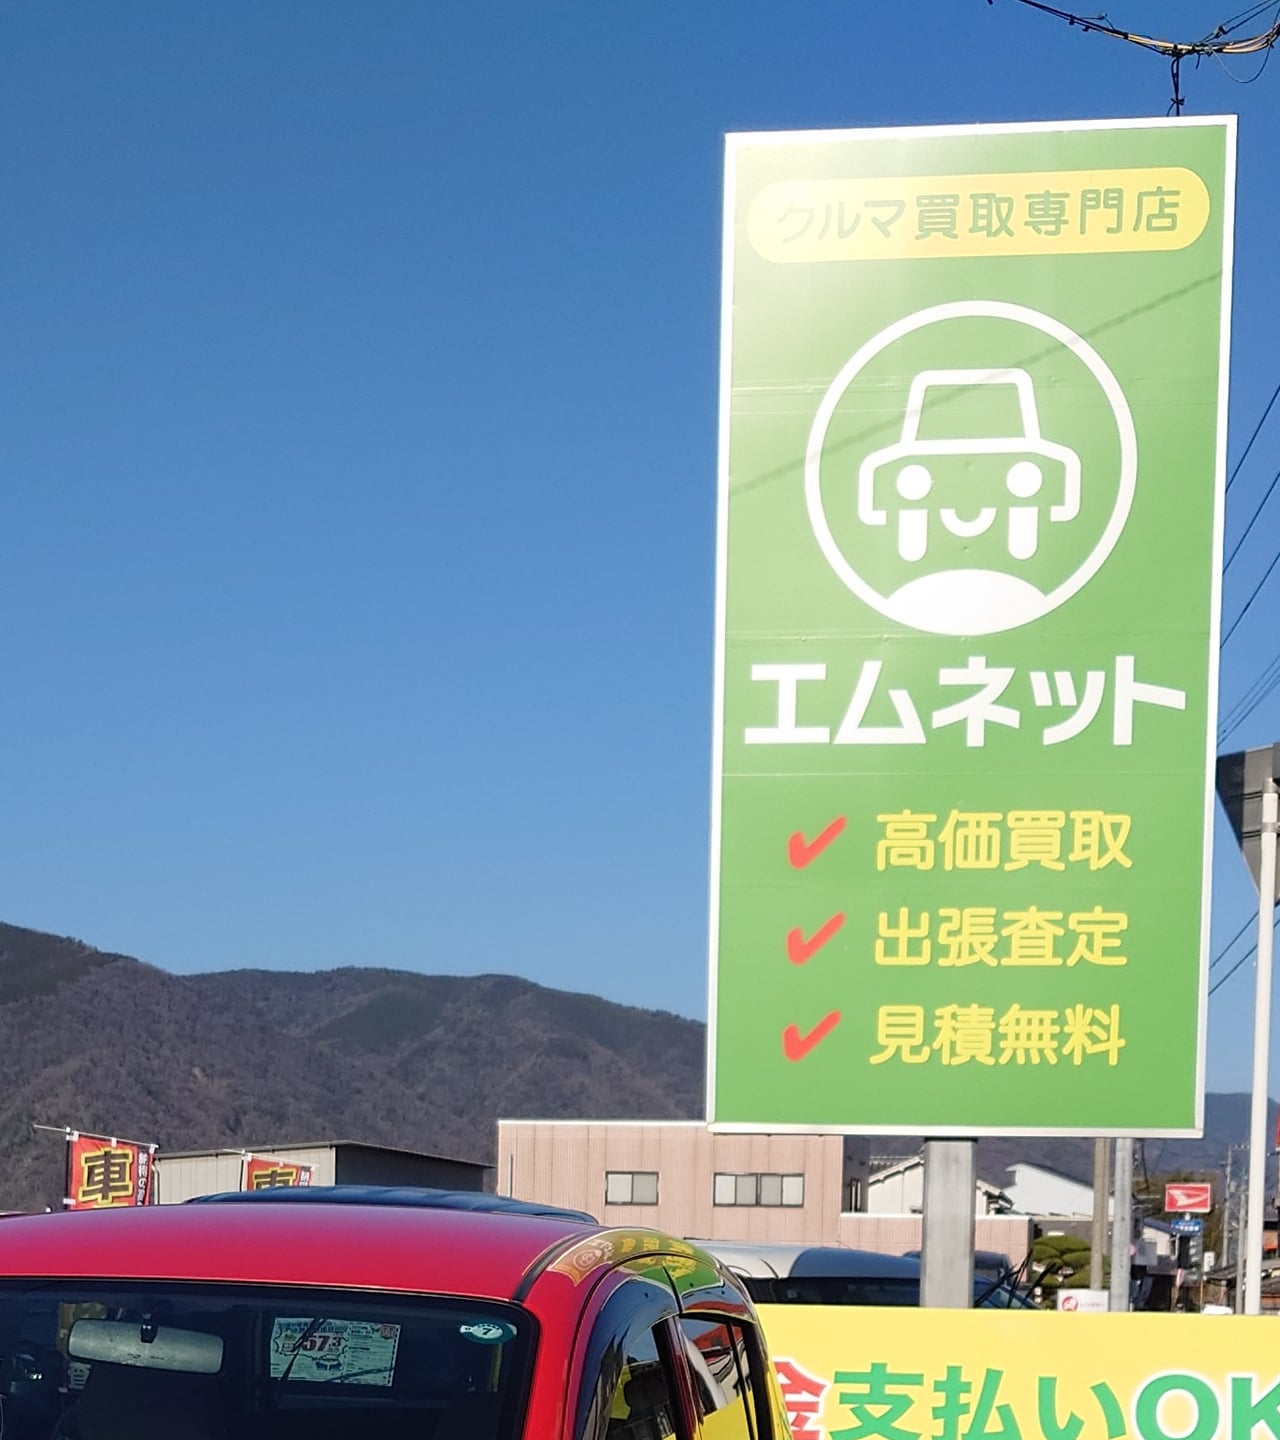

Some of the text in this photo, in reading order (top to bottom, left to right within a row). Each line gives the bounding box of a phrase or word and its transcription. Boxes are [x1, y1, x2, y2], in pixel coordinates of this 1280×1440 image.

[777, 186, 1182, 244] クルマ買取専門店
[745, 656, 1186, 747] エムネット
[876, 809, 1132, 871] 高価買取
[875, 906, 1127, 967] 出張査定
[870, 1004, 1125, 1065] 見積無料
